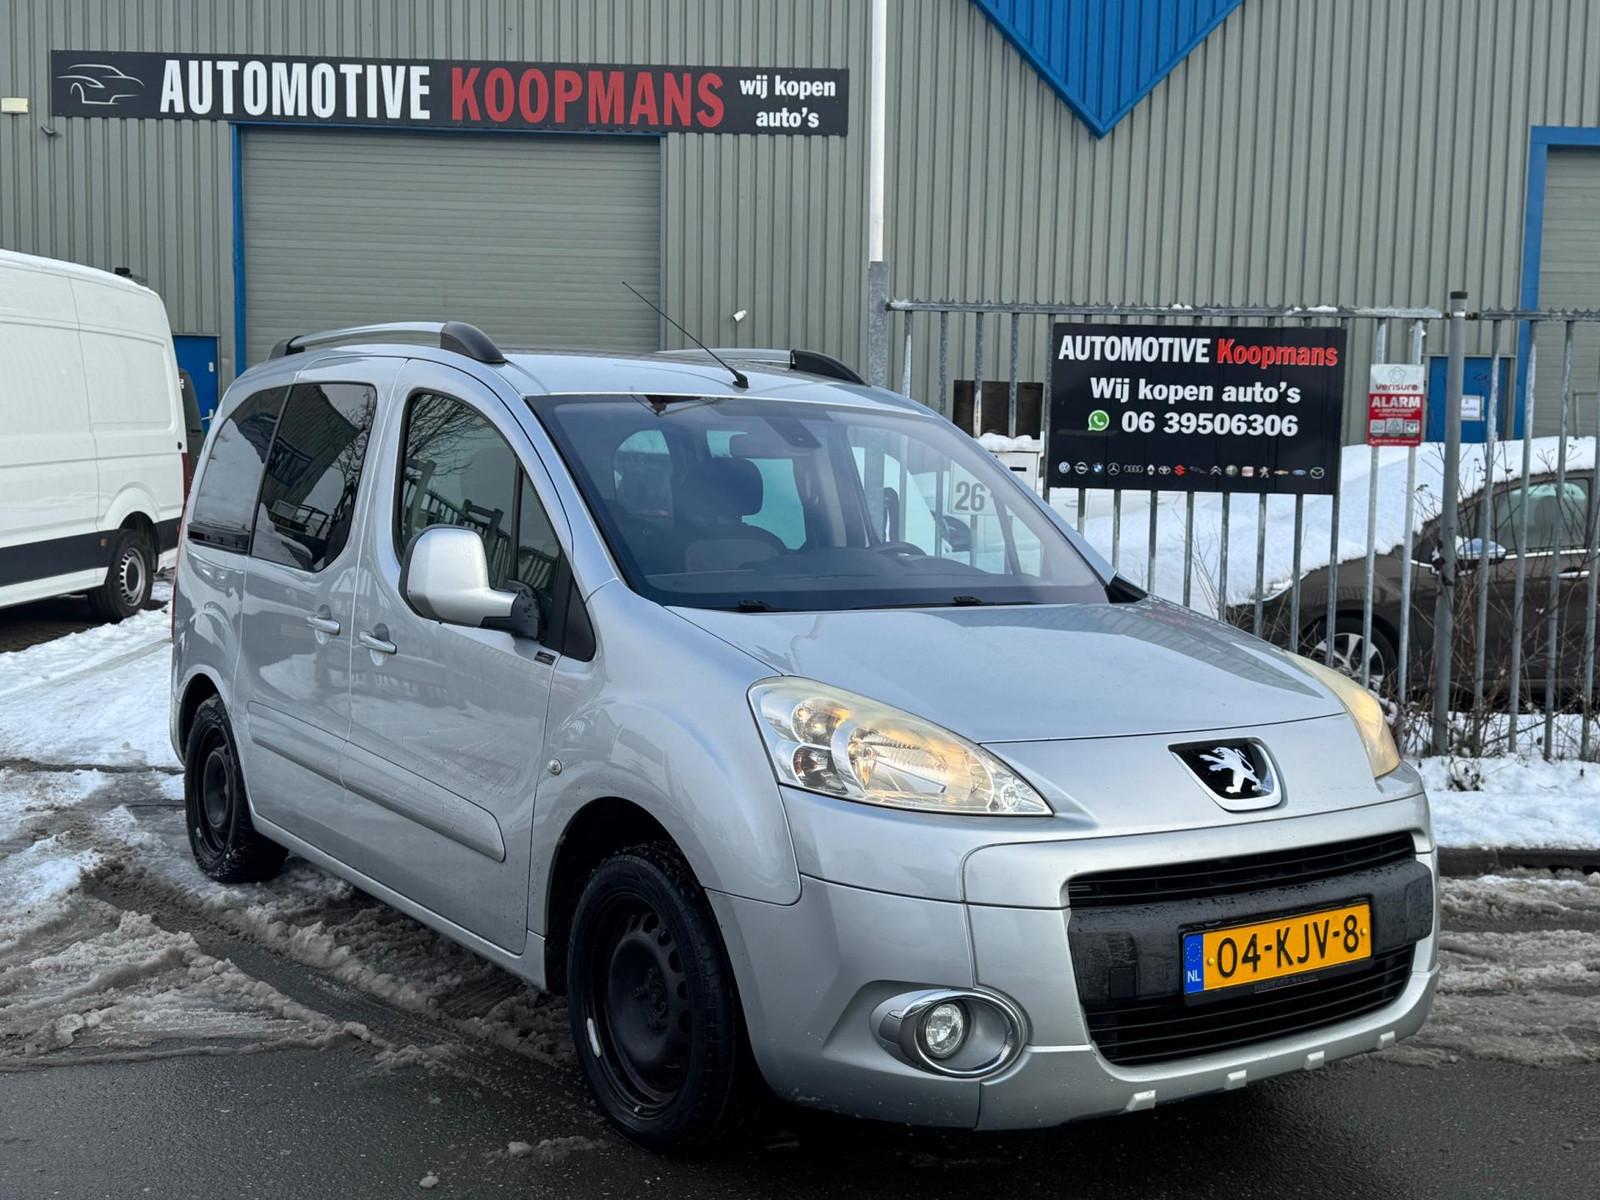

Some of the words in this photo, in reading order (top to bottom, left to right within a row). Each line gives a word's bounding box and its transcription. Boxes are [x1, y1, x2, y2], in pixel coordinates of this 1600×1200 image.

[160, 59, 430, 120] AUTOMOTIVE
[451, 67, 724, 127] KOOPMANS
[739, 75, 768, 99] wij
[774, 75, 837, 99] kopen
[1058, 335, 1211, 363] AUTOMOTIVE
[1216, 337, 1338, 369] Koopmans
[1090, 377, 1130, 403] Wij
[1138, 378, 1213, 404] kopen
[1375, 383, 1419, 392] verisure
[1371, 396, 1420, 408] ALARM
[1121, 411, 1156, 433] 06
[1163, 412, 1299, 437] 39506306
[954, 481, 986, 512] 26
[1216, 914, 1360, 978] 04-KJV-8
[1187, 971, 1201, 983] NL
